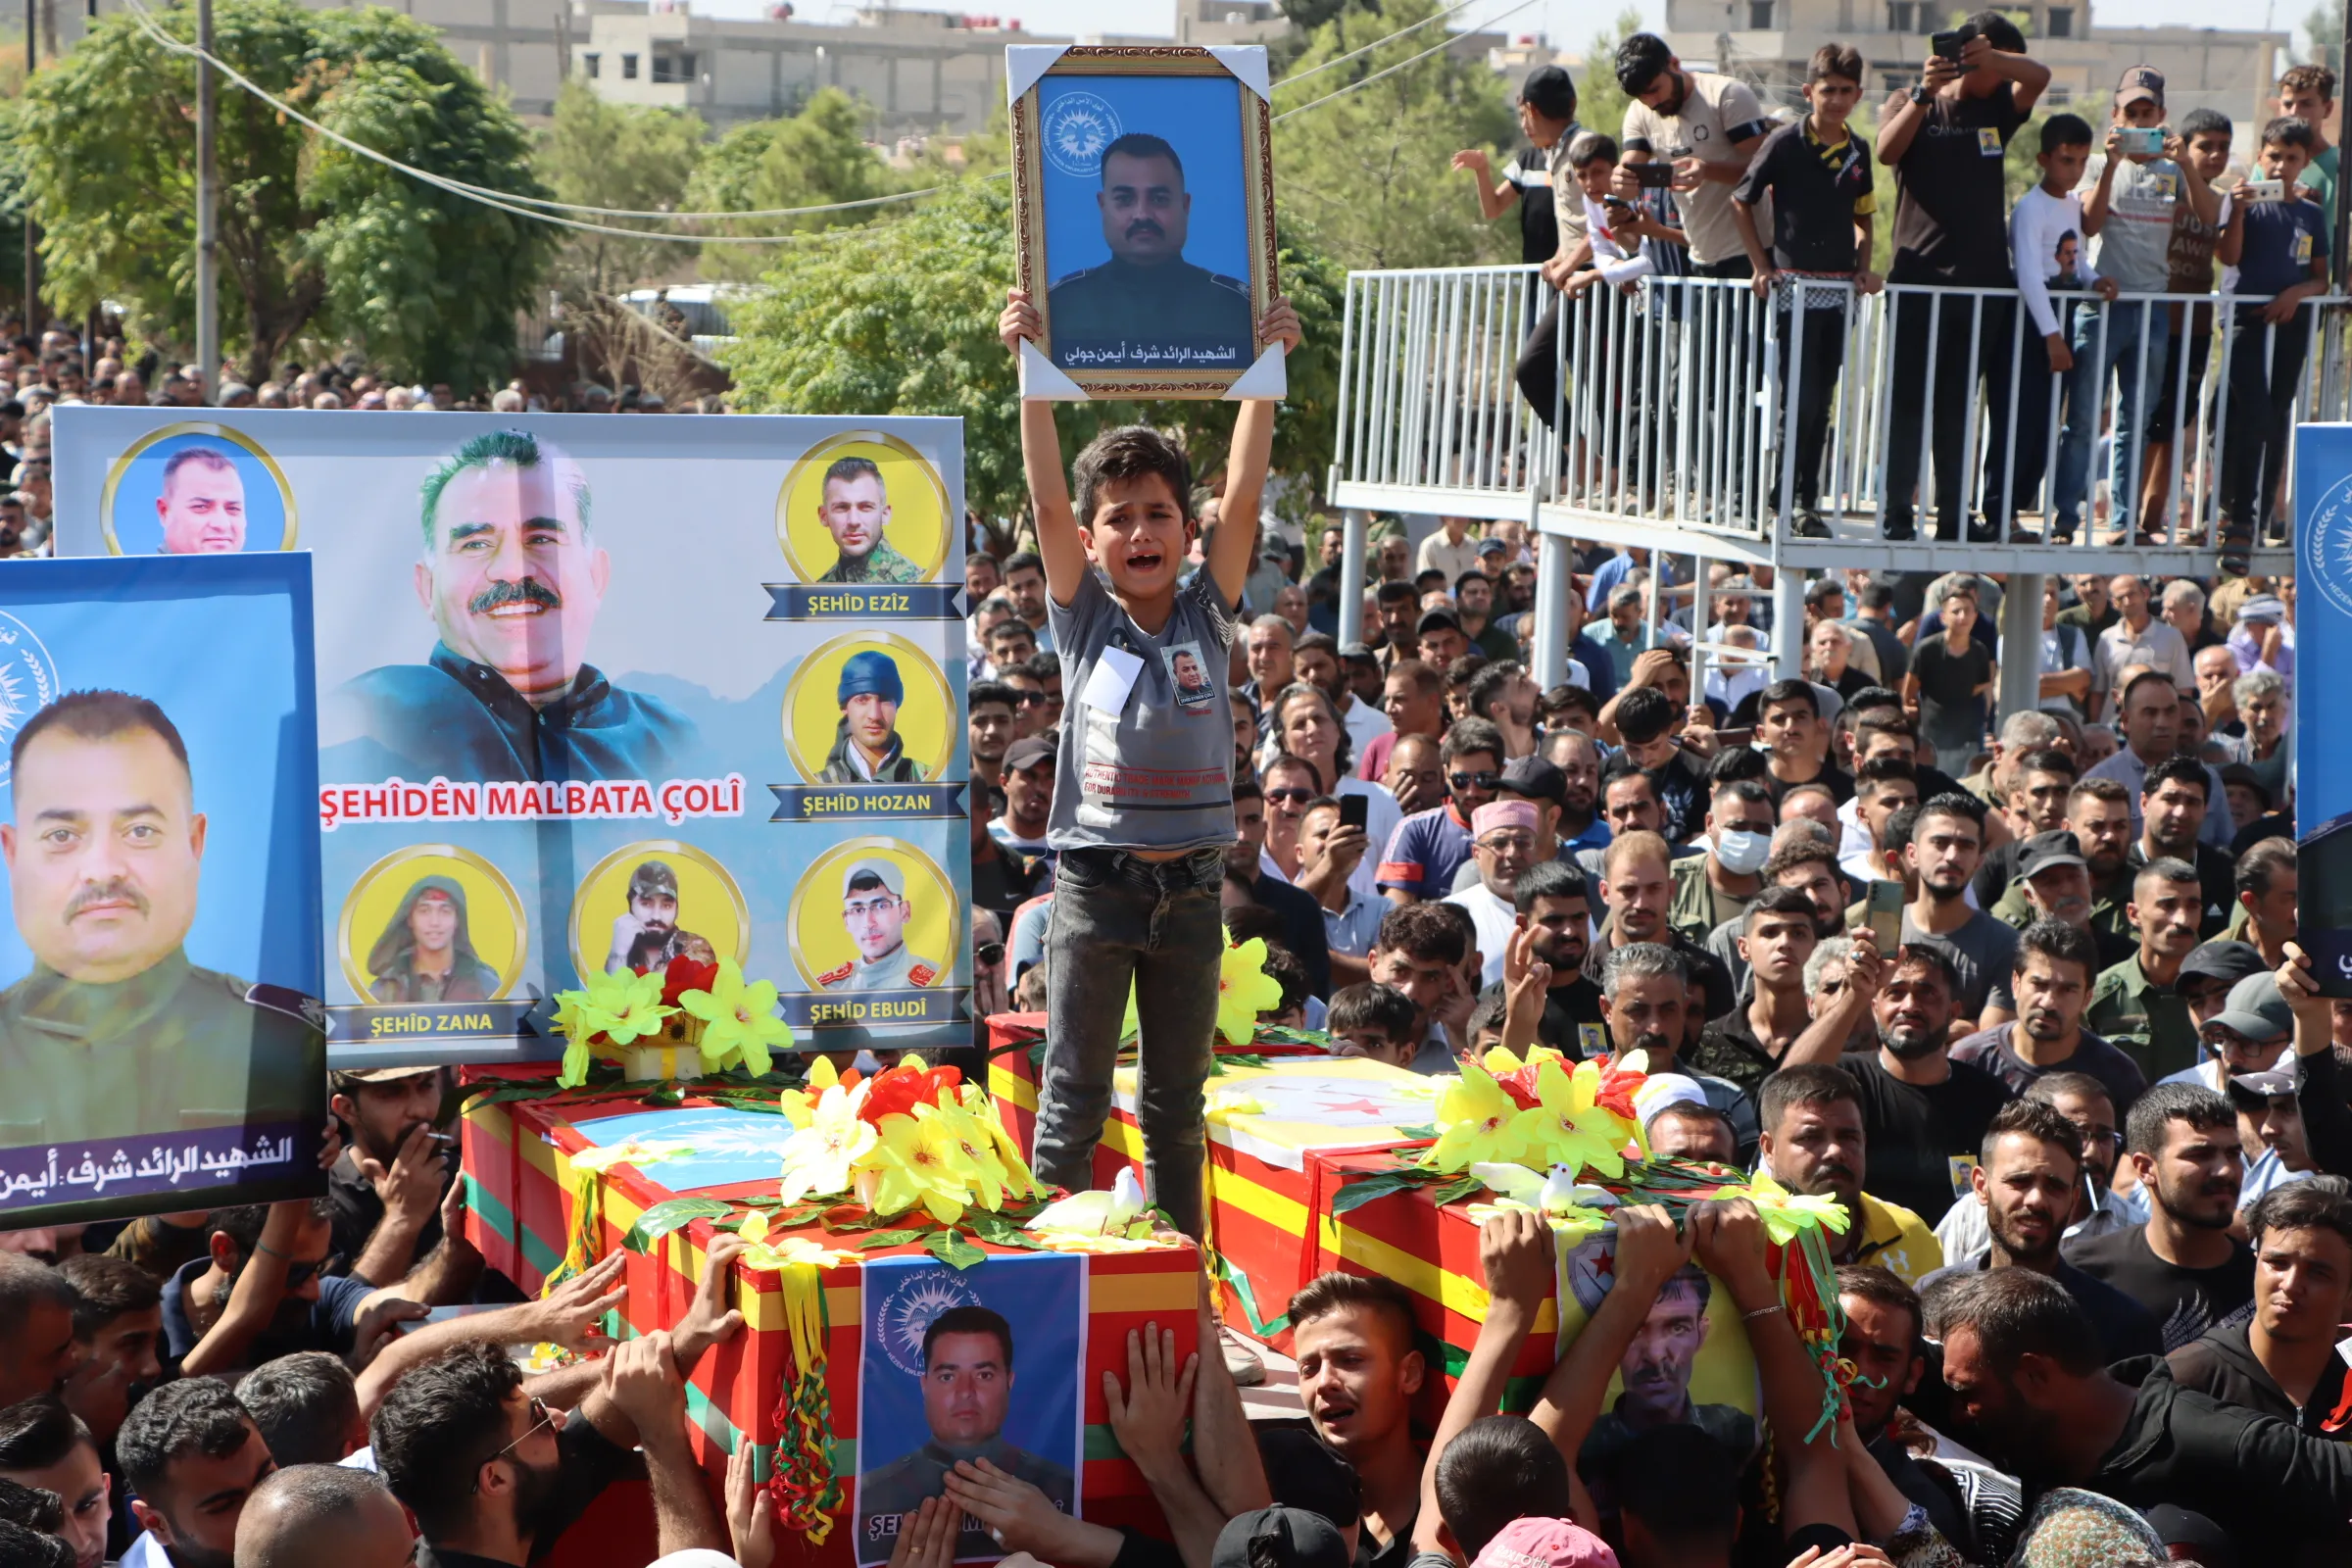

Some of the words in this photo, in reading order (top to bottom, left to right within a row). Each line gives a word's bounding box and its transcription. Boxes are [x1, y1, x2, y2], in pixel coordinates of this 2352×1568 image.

[1065, 347, 1095, 366] جولي
[1097, 341, 1126, 363] أيمن
[1161, 345, 1191, 364] الرائد
[1192, 345, 1235, 364] الشهيد
[808, 593, 864, 616] ŞEHÎD
[869, 592, 909, 612] EZÎZ
[319, 782, 475, 826] ŞEHÎDÊN
[487, 785, 653, 815] MALBATA
[662, 777, 740, 820] ÇOLÎ
[803, 793, 859, 816] ŞEHÎD
[863, 795, 931, 811] HOZAN
[808, 1000, 866, 1025] ŞEHÎD
[870, 997, 927, 1018] EBUDÎ
[370, 1012, 432, 1038] ŞEHÎD
[435, 1013, 494, 1031] ZANA
[135, 1146, 199, 1184] الرائد
[200, 1135, 293, 1178] الشهيد
